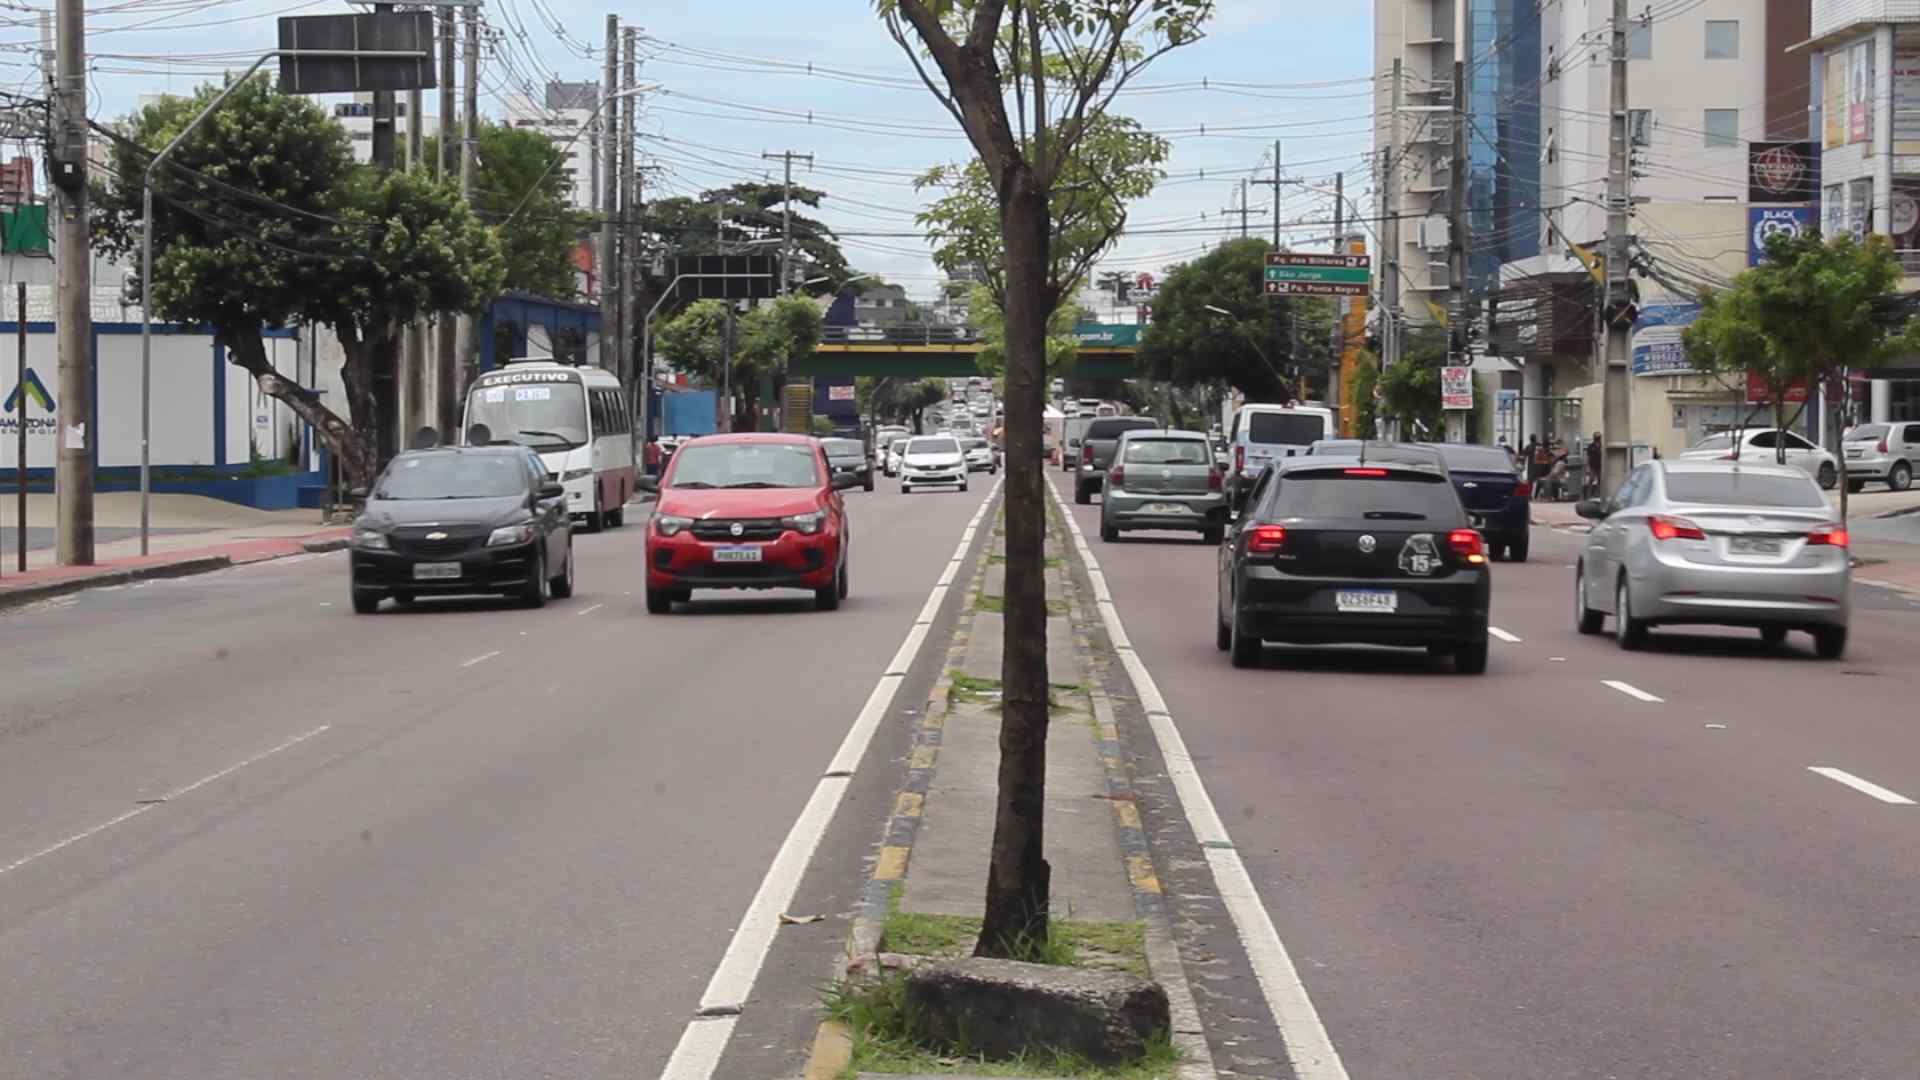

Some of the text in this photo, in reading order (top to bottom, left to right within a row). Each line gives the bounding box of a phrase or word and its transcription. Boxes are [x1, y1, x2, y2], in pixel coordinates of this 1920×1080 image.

[1763, 209, 1794, 219] BLACK
[483, 372, 569, 386] EXECUTIVO
[1410, 554, 1429, 572] 15
